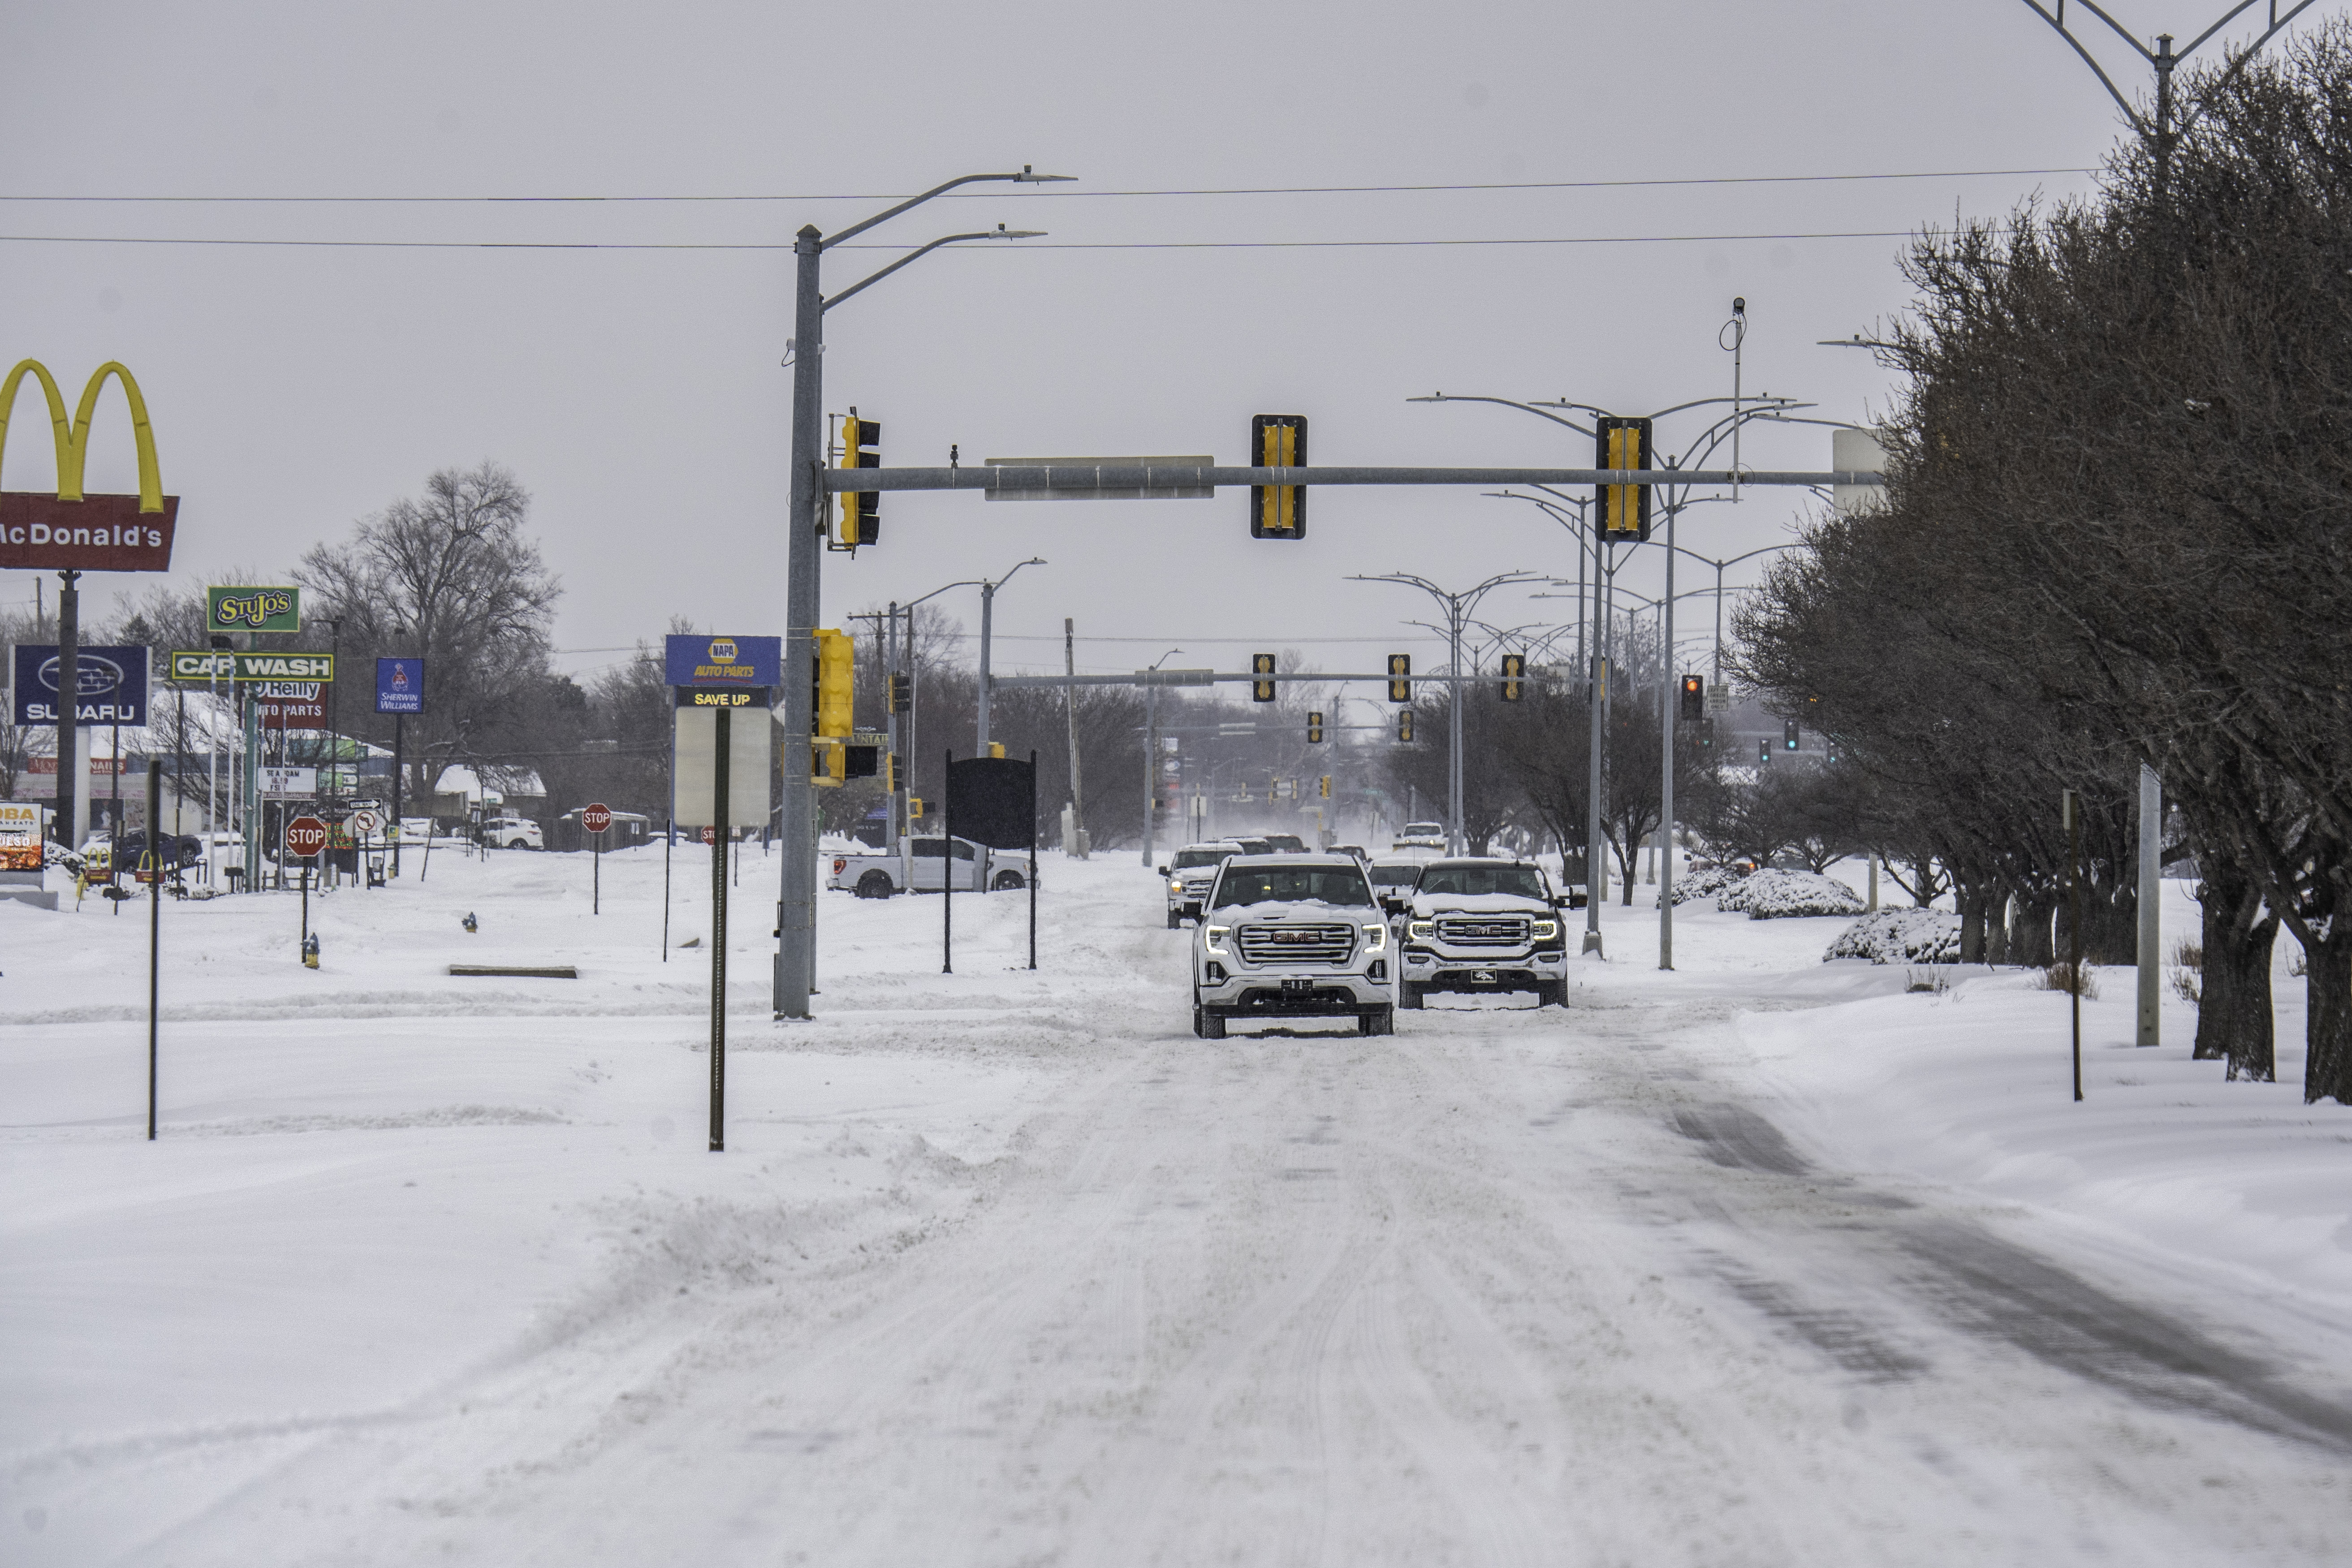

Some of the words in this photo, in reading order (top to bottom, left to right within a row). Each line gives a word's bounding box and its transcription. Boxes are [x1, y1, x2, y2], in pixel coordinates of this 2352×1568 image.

[713, 645, 734, 657] NAPA
[177, 657, 237, 674] CAR
[245, 658, 329, 675] WASH
[694, 665, 722, 676] AUTO
[723, 666, 754, 677] PARTS
[381, 692, 418, 701] SHERWIN
[695, 693, 729, 705] SAVE
[732, 695, 751, 705] UP
[380, 700, 419, 710] WILLIAMS
[27, 704, 134, 720] SUARU
[585, 812, 610, 823] STOP
[289, 829, 324, 844] STOP
[703, 830, 715, 839] ST
[1466, 925, 1502, 935] GMC
[1273, 932, 1320, 942] GMC
